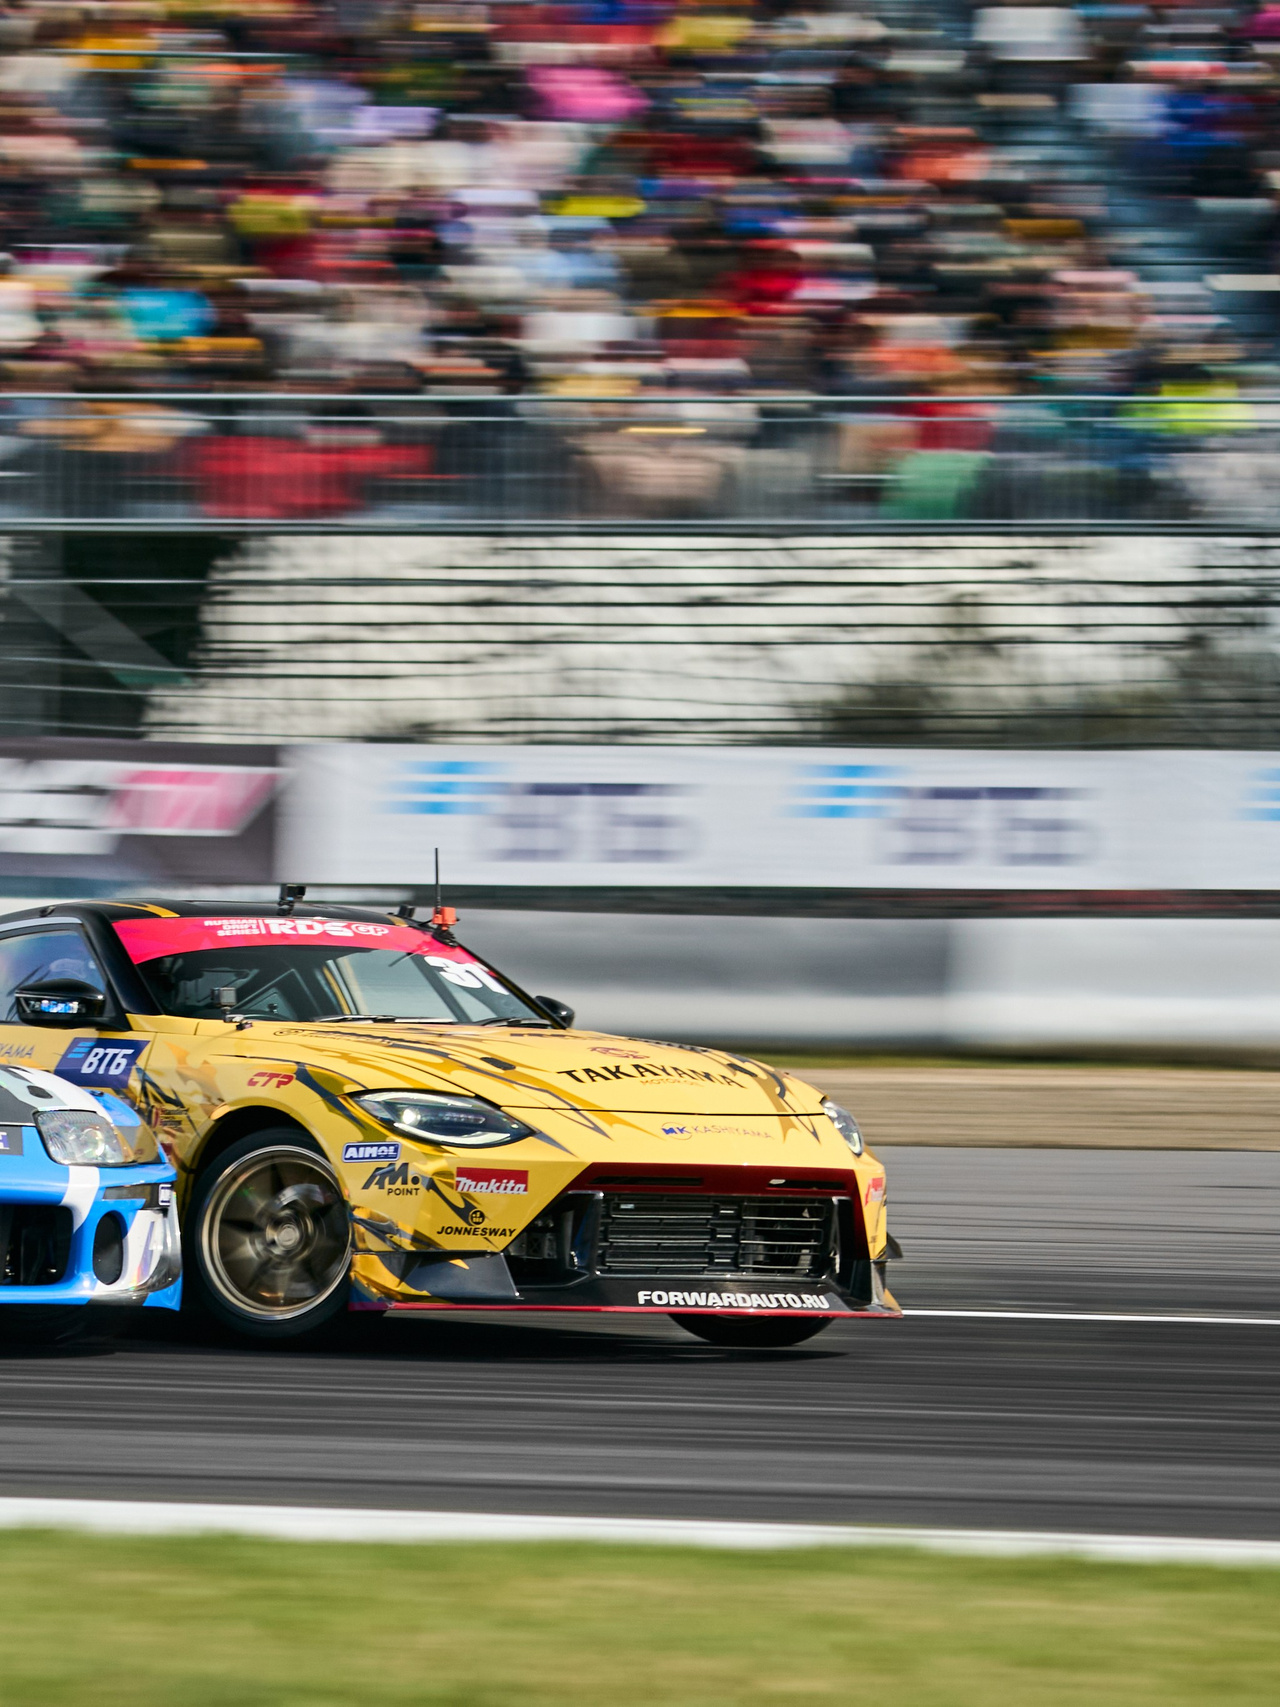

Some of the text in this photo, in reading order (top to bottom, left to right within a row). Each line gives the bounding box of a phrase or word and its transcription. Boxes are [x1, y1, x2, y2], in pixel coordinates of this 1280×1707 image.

[217, 929, 261, 937] SERIES
[264, 919, 354, 937] RDS
[424, 956, 510, 996] 31
[81, 1048, 134, 1076] ВТБ
[557, 1063, 748, 1089] TAKAYAMA
[344, 1146, 397, 1158] AIMOL
[387, 1187, 421, 1197] POINT
[436, 1225, 517, 1238] JONNESWAY
[637, 1290, 830, 1310] FORWARDAUTO.RU
